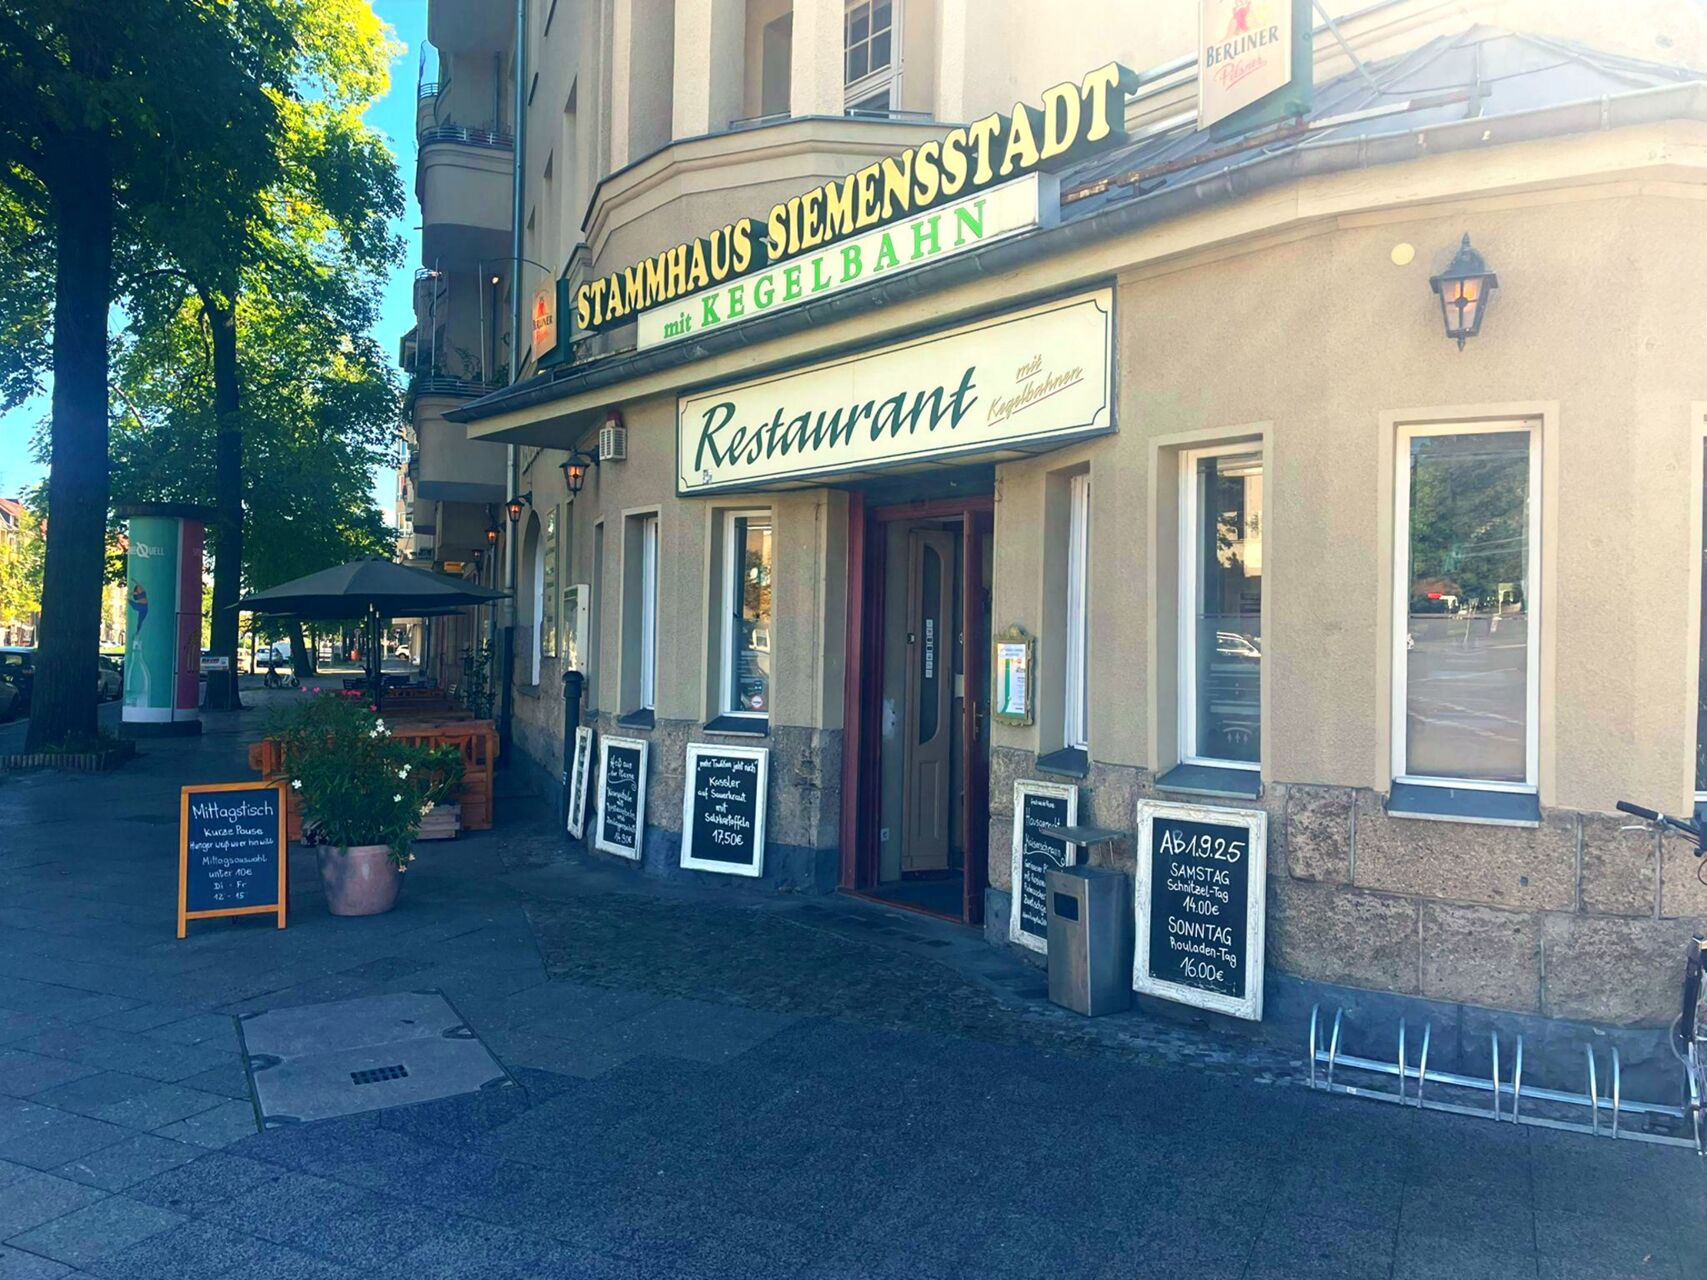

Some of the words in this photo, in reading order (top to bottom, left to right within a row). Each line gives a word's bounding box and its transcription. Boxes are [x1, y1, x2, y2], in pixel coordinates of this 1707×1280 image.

[1206, 25, 1279, 68] BERLINER
[577, 217, 752, 330] STAMMHAUS
[767, 61, 1120, 261] SIEMENSSTADT
[663, 311, 693, 339] mit
[701, 199, 986, 328] KEGELBAHN
[1015, 353, 1042, 380] mit
[694, 366, 979, 472] Restaurant
[986, 366, 1084, 421] Kegelbahnen
[709, 776, 741, 789] Kassler
[192, 800, 274, 823] Mittagstisch
[203, 827, 234, 838] Kurze
[235, 824, 264, 836] Pause
[202, 854, 268, 868] Mittagsauswahl
[208, 868, 233, 879] unter
[213, 882, 224, 890] Di
[236, 881, 247, 889] Fr
[1170, 862, 1230, 885] SAMSTAG
[213, 893, 225, 901] 12
[235, 892, 246, 900] 15
[1167, 878, 1229, 903] Schnitzel-Tag
[1183, 896, 1220, 916] 14.00€
[1168, 916, 1233, 946] SONNTAG
[1169, 936, 1237, 968] Rouladen-Tag
[1180, 957, 1225, 982] 16.00€
